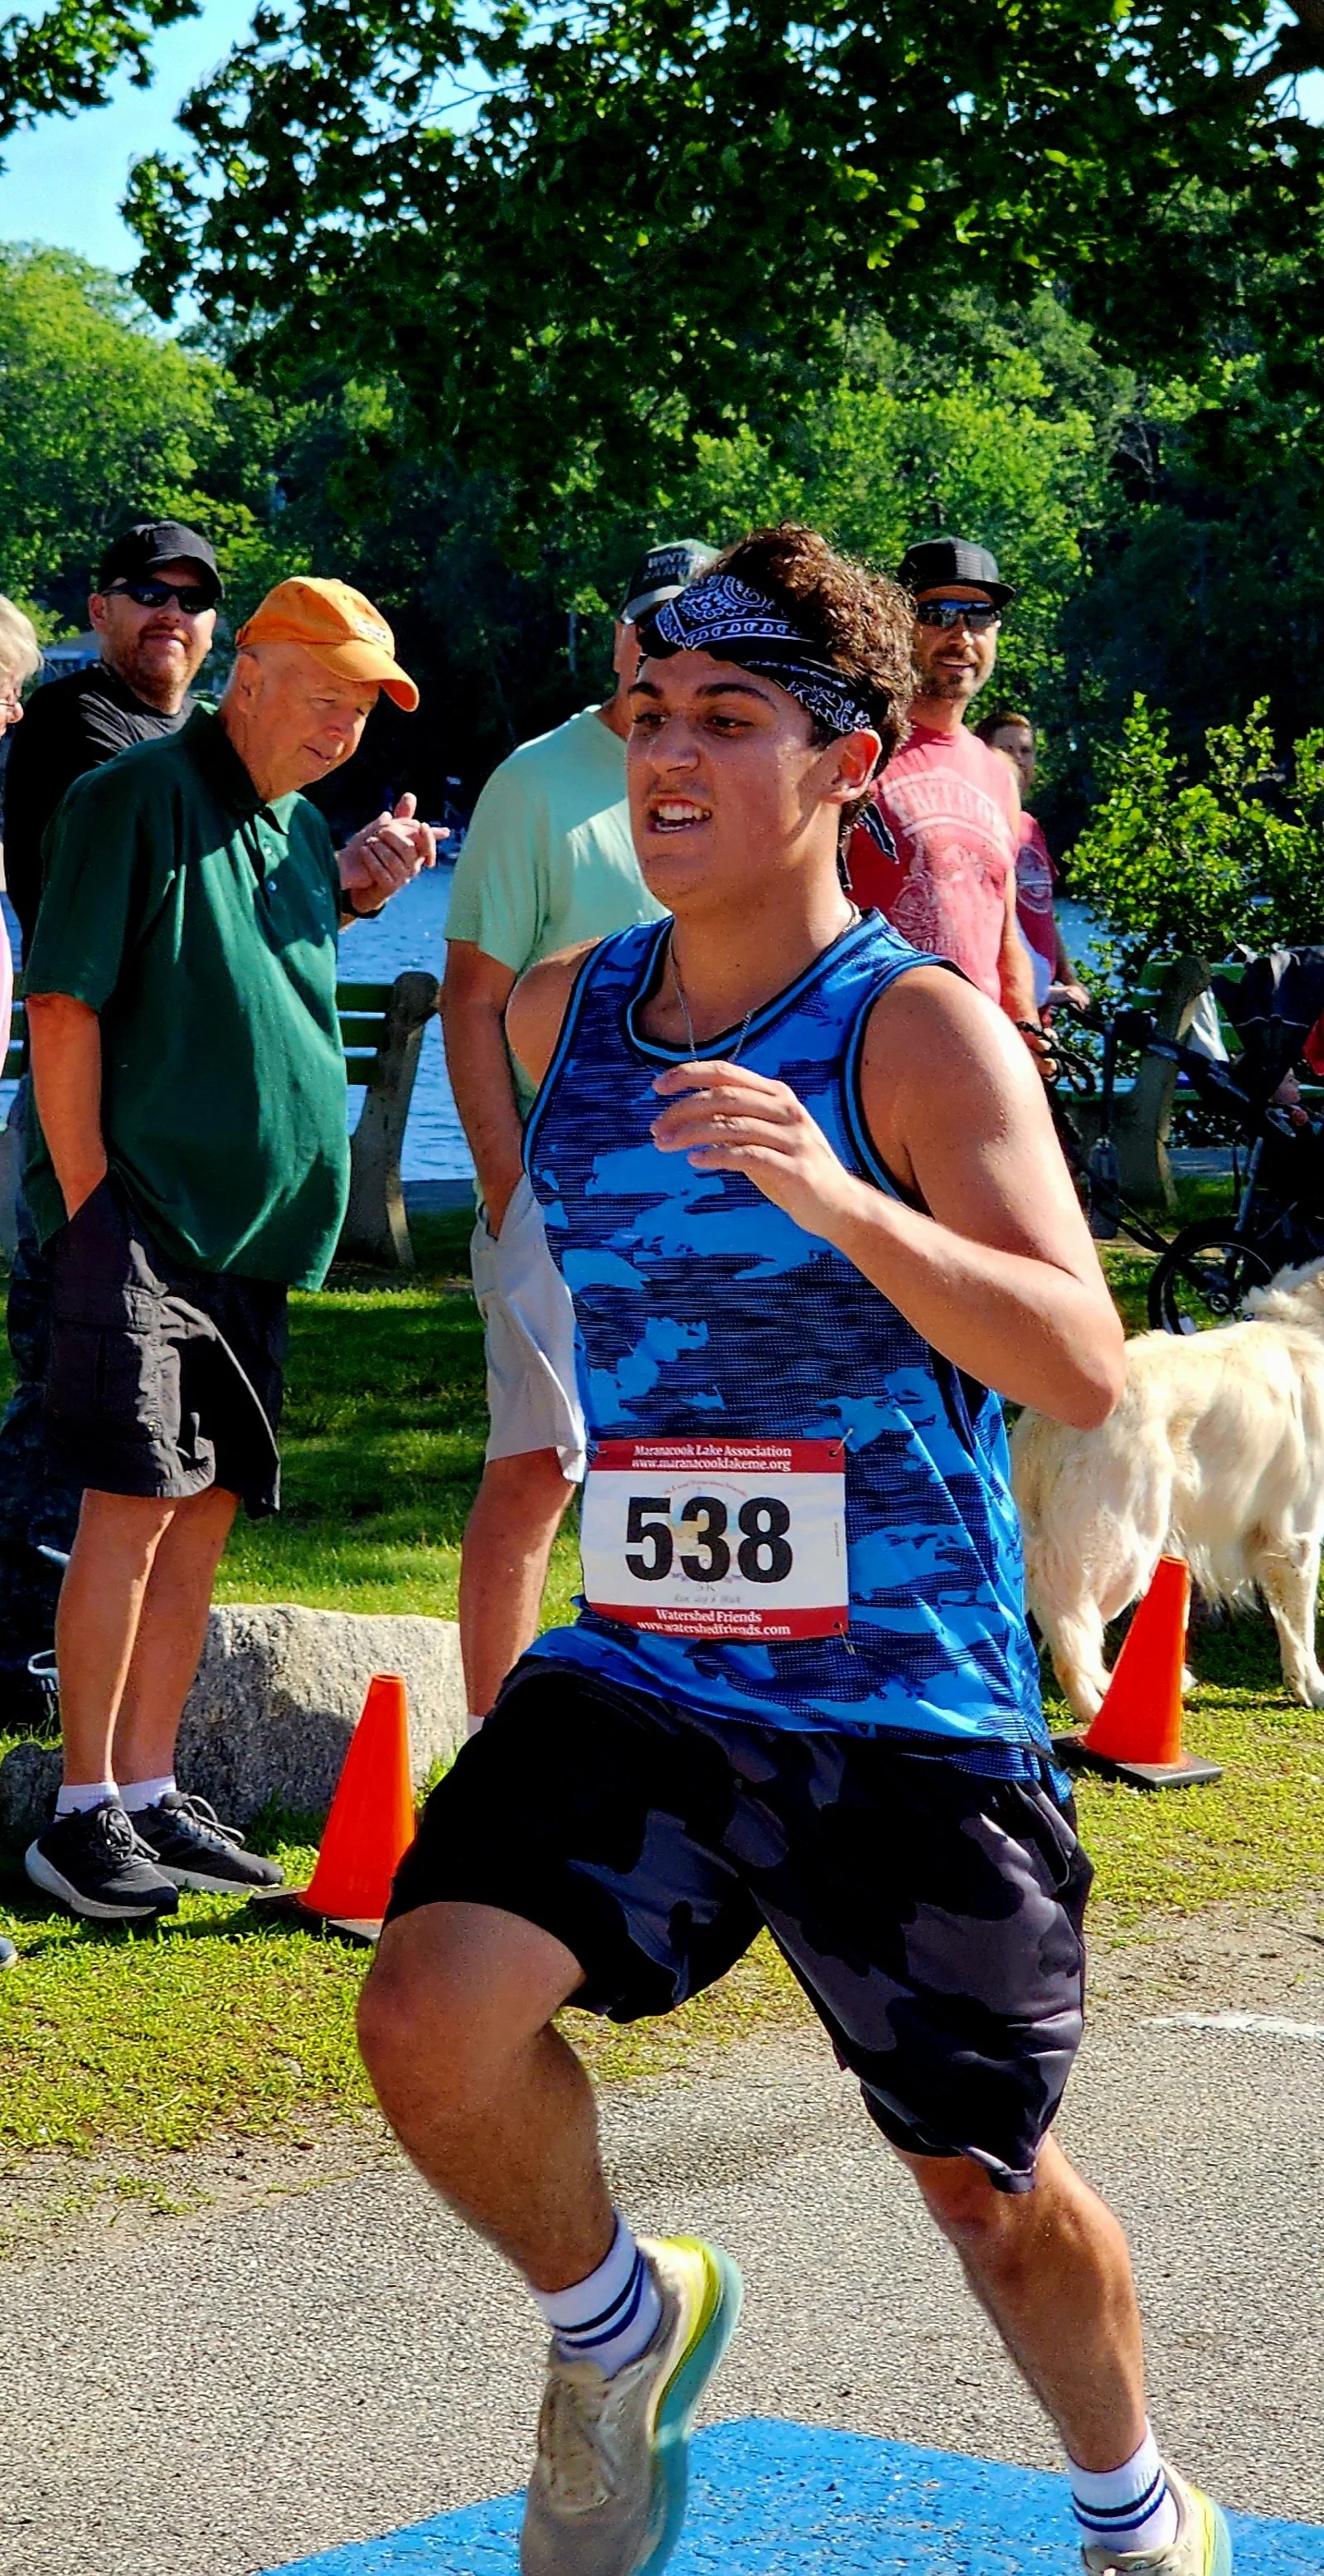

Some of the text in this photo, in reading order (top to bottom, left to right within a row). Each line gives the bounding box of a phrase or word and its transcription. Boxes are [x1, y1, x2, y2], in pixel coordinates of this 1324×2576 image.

[633, 1445, 792, 1457] Maranacook Lake Association
[625, 1496, 793, 1583] 538
[656, 1609, 763, 1624] Watershed Friends
[637, 1621, 791, 1636] www.watershedfriends.com
